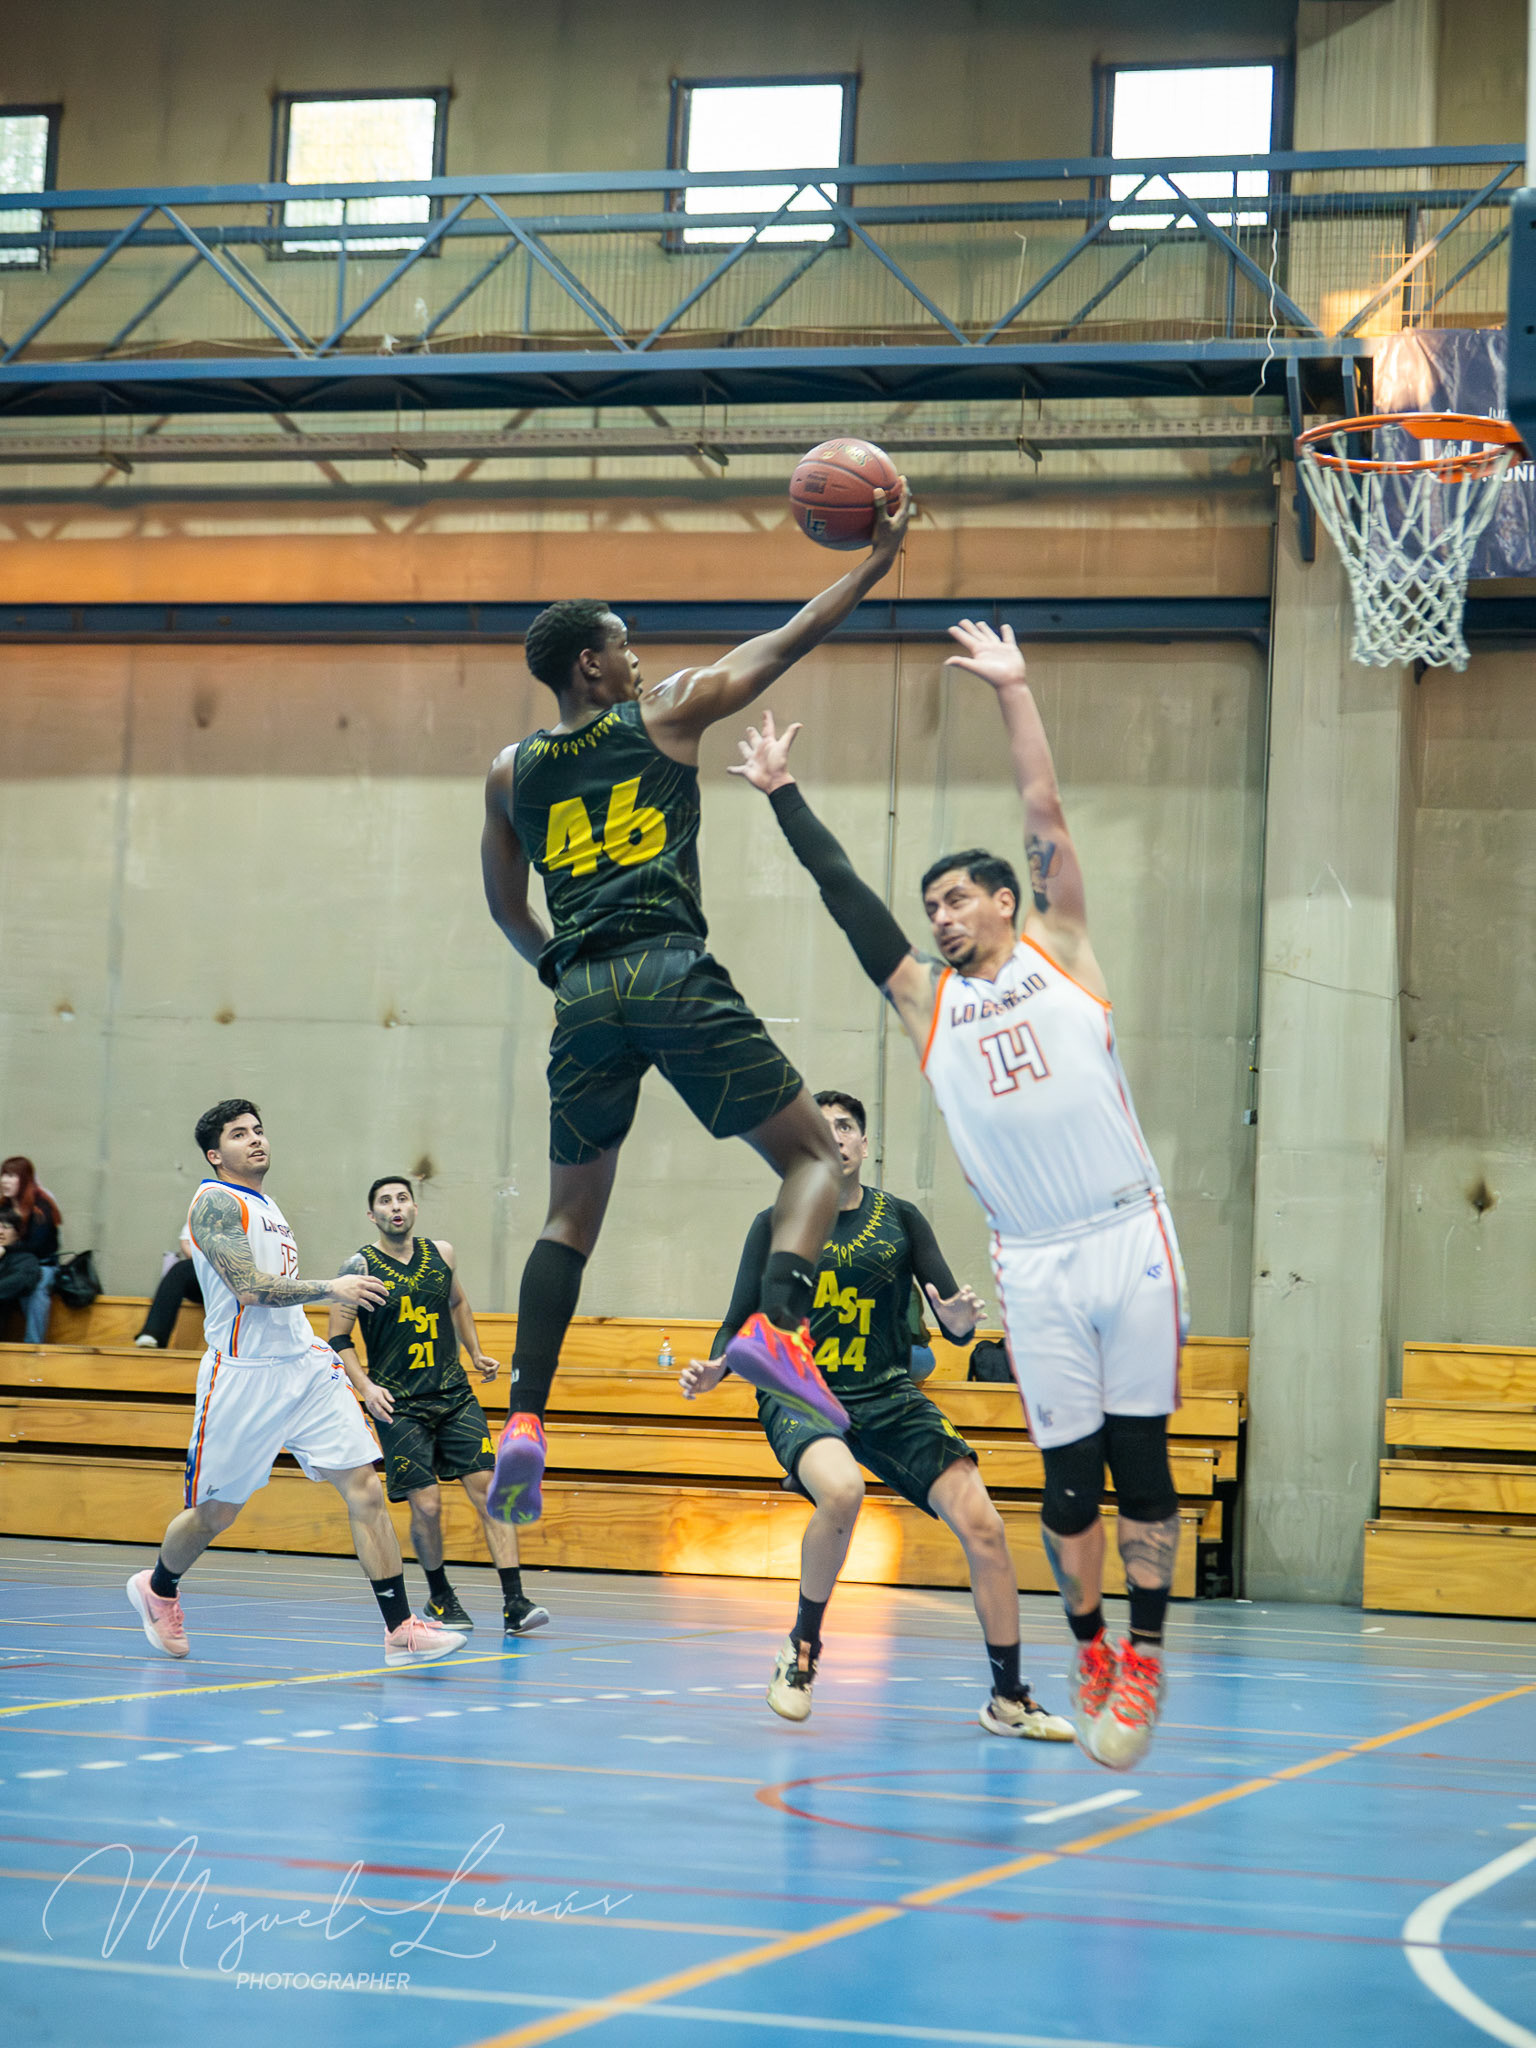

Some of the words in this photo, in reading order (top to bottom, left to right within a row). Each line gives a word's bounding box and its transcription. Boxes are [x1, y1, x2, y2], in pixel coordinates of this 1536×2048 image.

[542, 776, 667, 877] 46
[951, 1003, 975, 1028] LO
[979, 1021, 1051, 1097] 14
[397, 1295, 440, 1340] AST
[812, 1270, 876, 1335] AST
[408, 1341, 435, 1370] 21
[814, 1336, 867, 1373] 44
